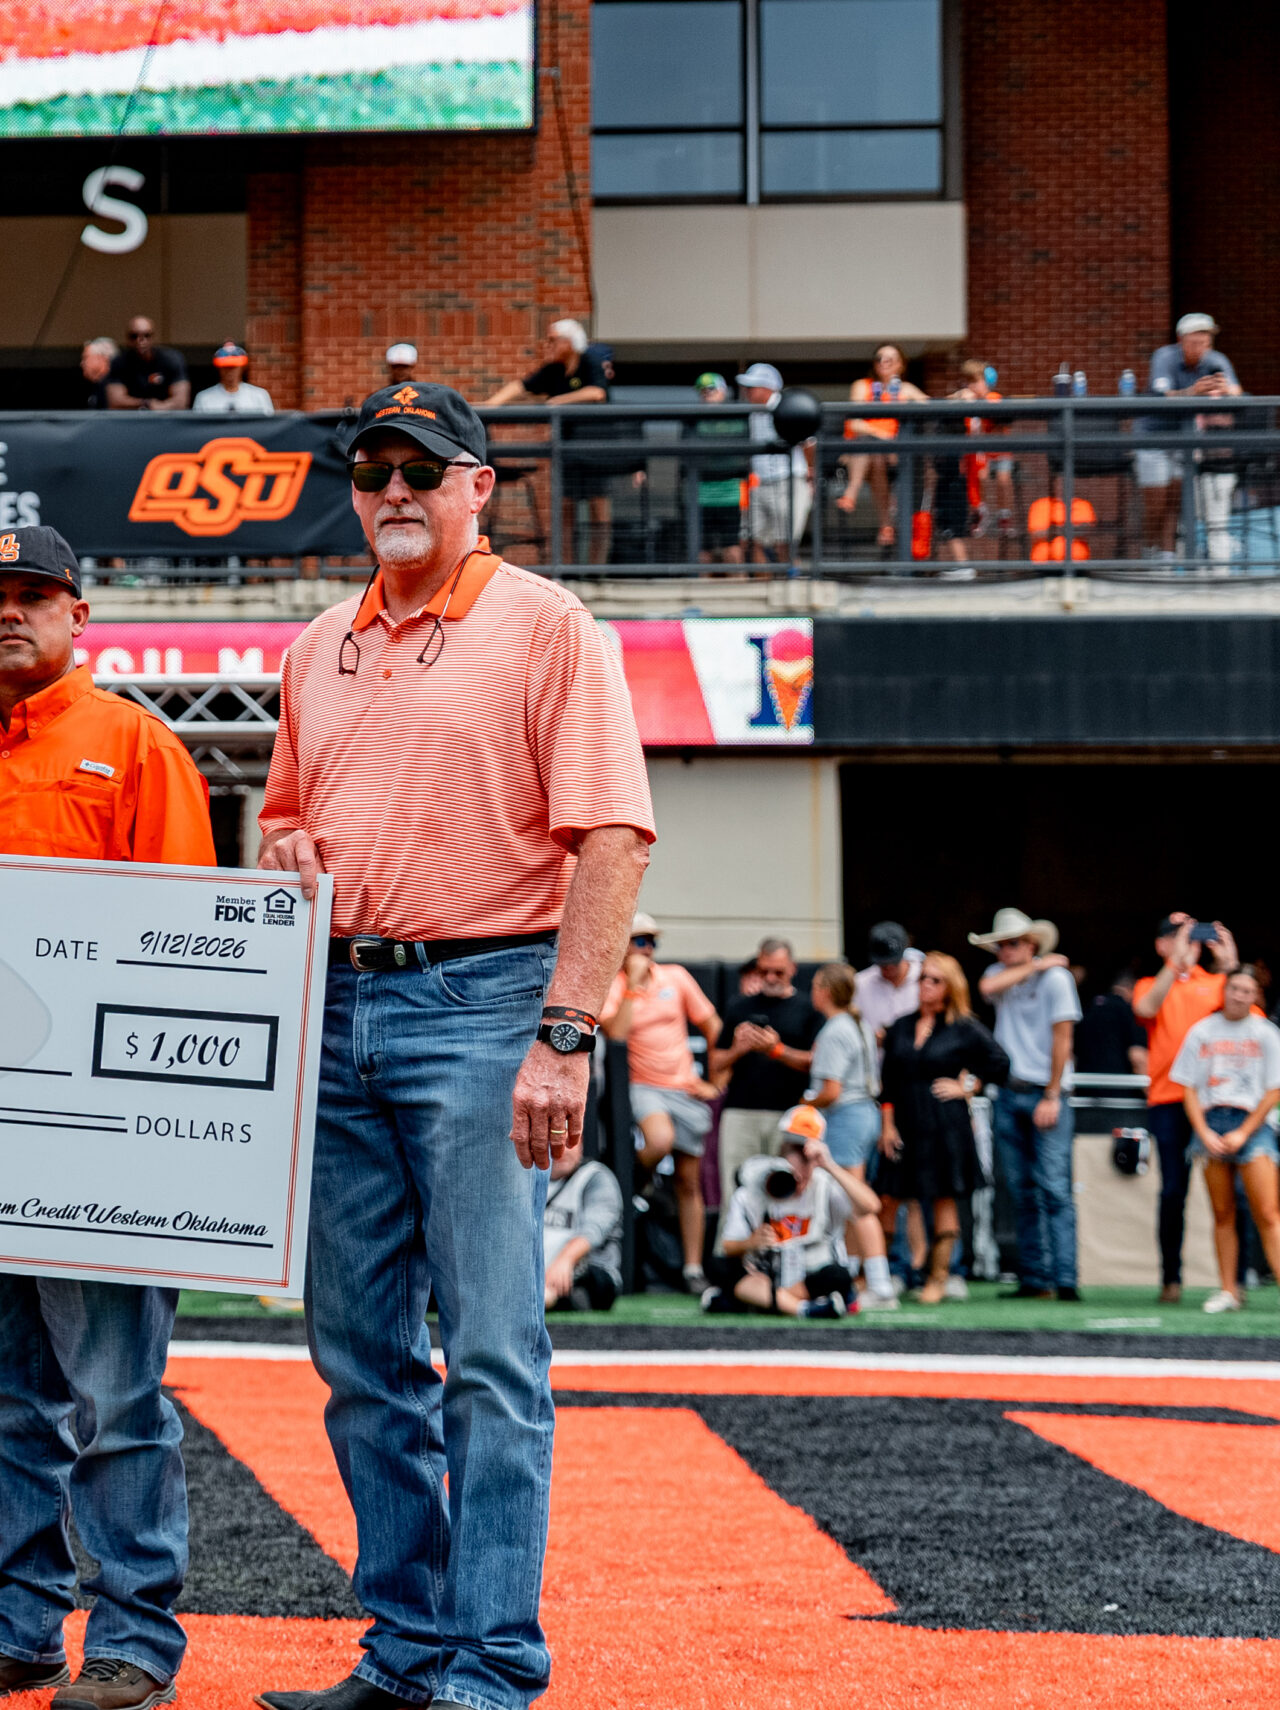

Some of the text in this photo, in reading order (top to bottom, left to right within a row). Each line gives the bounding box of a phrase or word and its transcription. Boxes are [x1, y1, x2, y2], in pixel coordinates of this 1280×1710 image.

[128, 437, 313, 537] OSU
[215, 904, 256, 923] FDIC
[216, 895, 256, 905] Member
[262, 918, 295, 926] LENDER
[35, 931, 248, 961] DATE 9/12/2026
[125, 1031, 241, 1069] $ 1,000
[135, 1115, 253, 1144] DOLLARS
[20, 1198, 82, 1221] Credit
[83, 1203, 169, 1229] Western
[172, 1210, 269, 1237] Oklahoma
